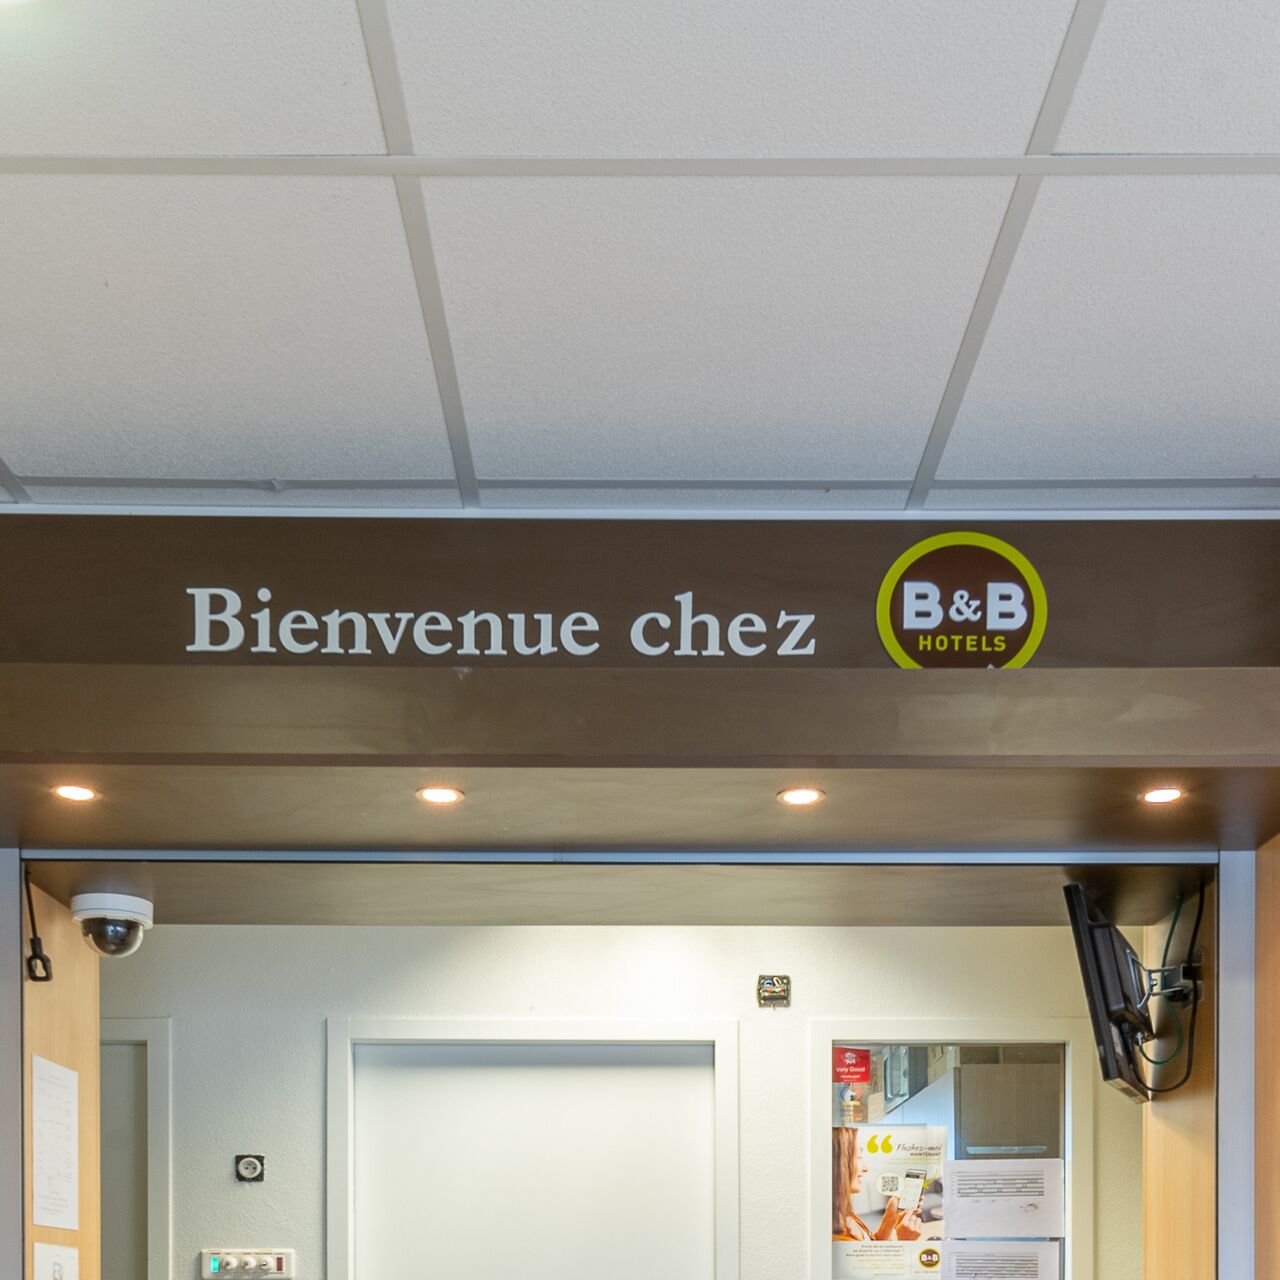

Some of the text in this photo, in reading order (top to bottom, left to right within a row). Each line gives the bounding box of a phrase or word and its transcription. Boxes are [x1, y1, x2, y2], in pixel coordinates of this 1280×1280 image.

[185, 587, 816, 657] Bienvenue chez
[903, 581, 1027, 631] B&B
[918, 635, 1007, 652] HOTELS
